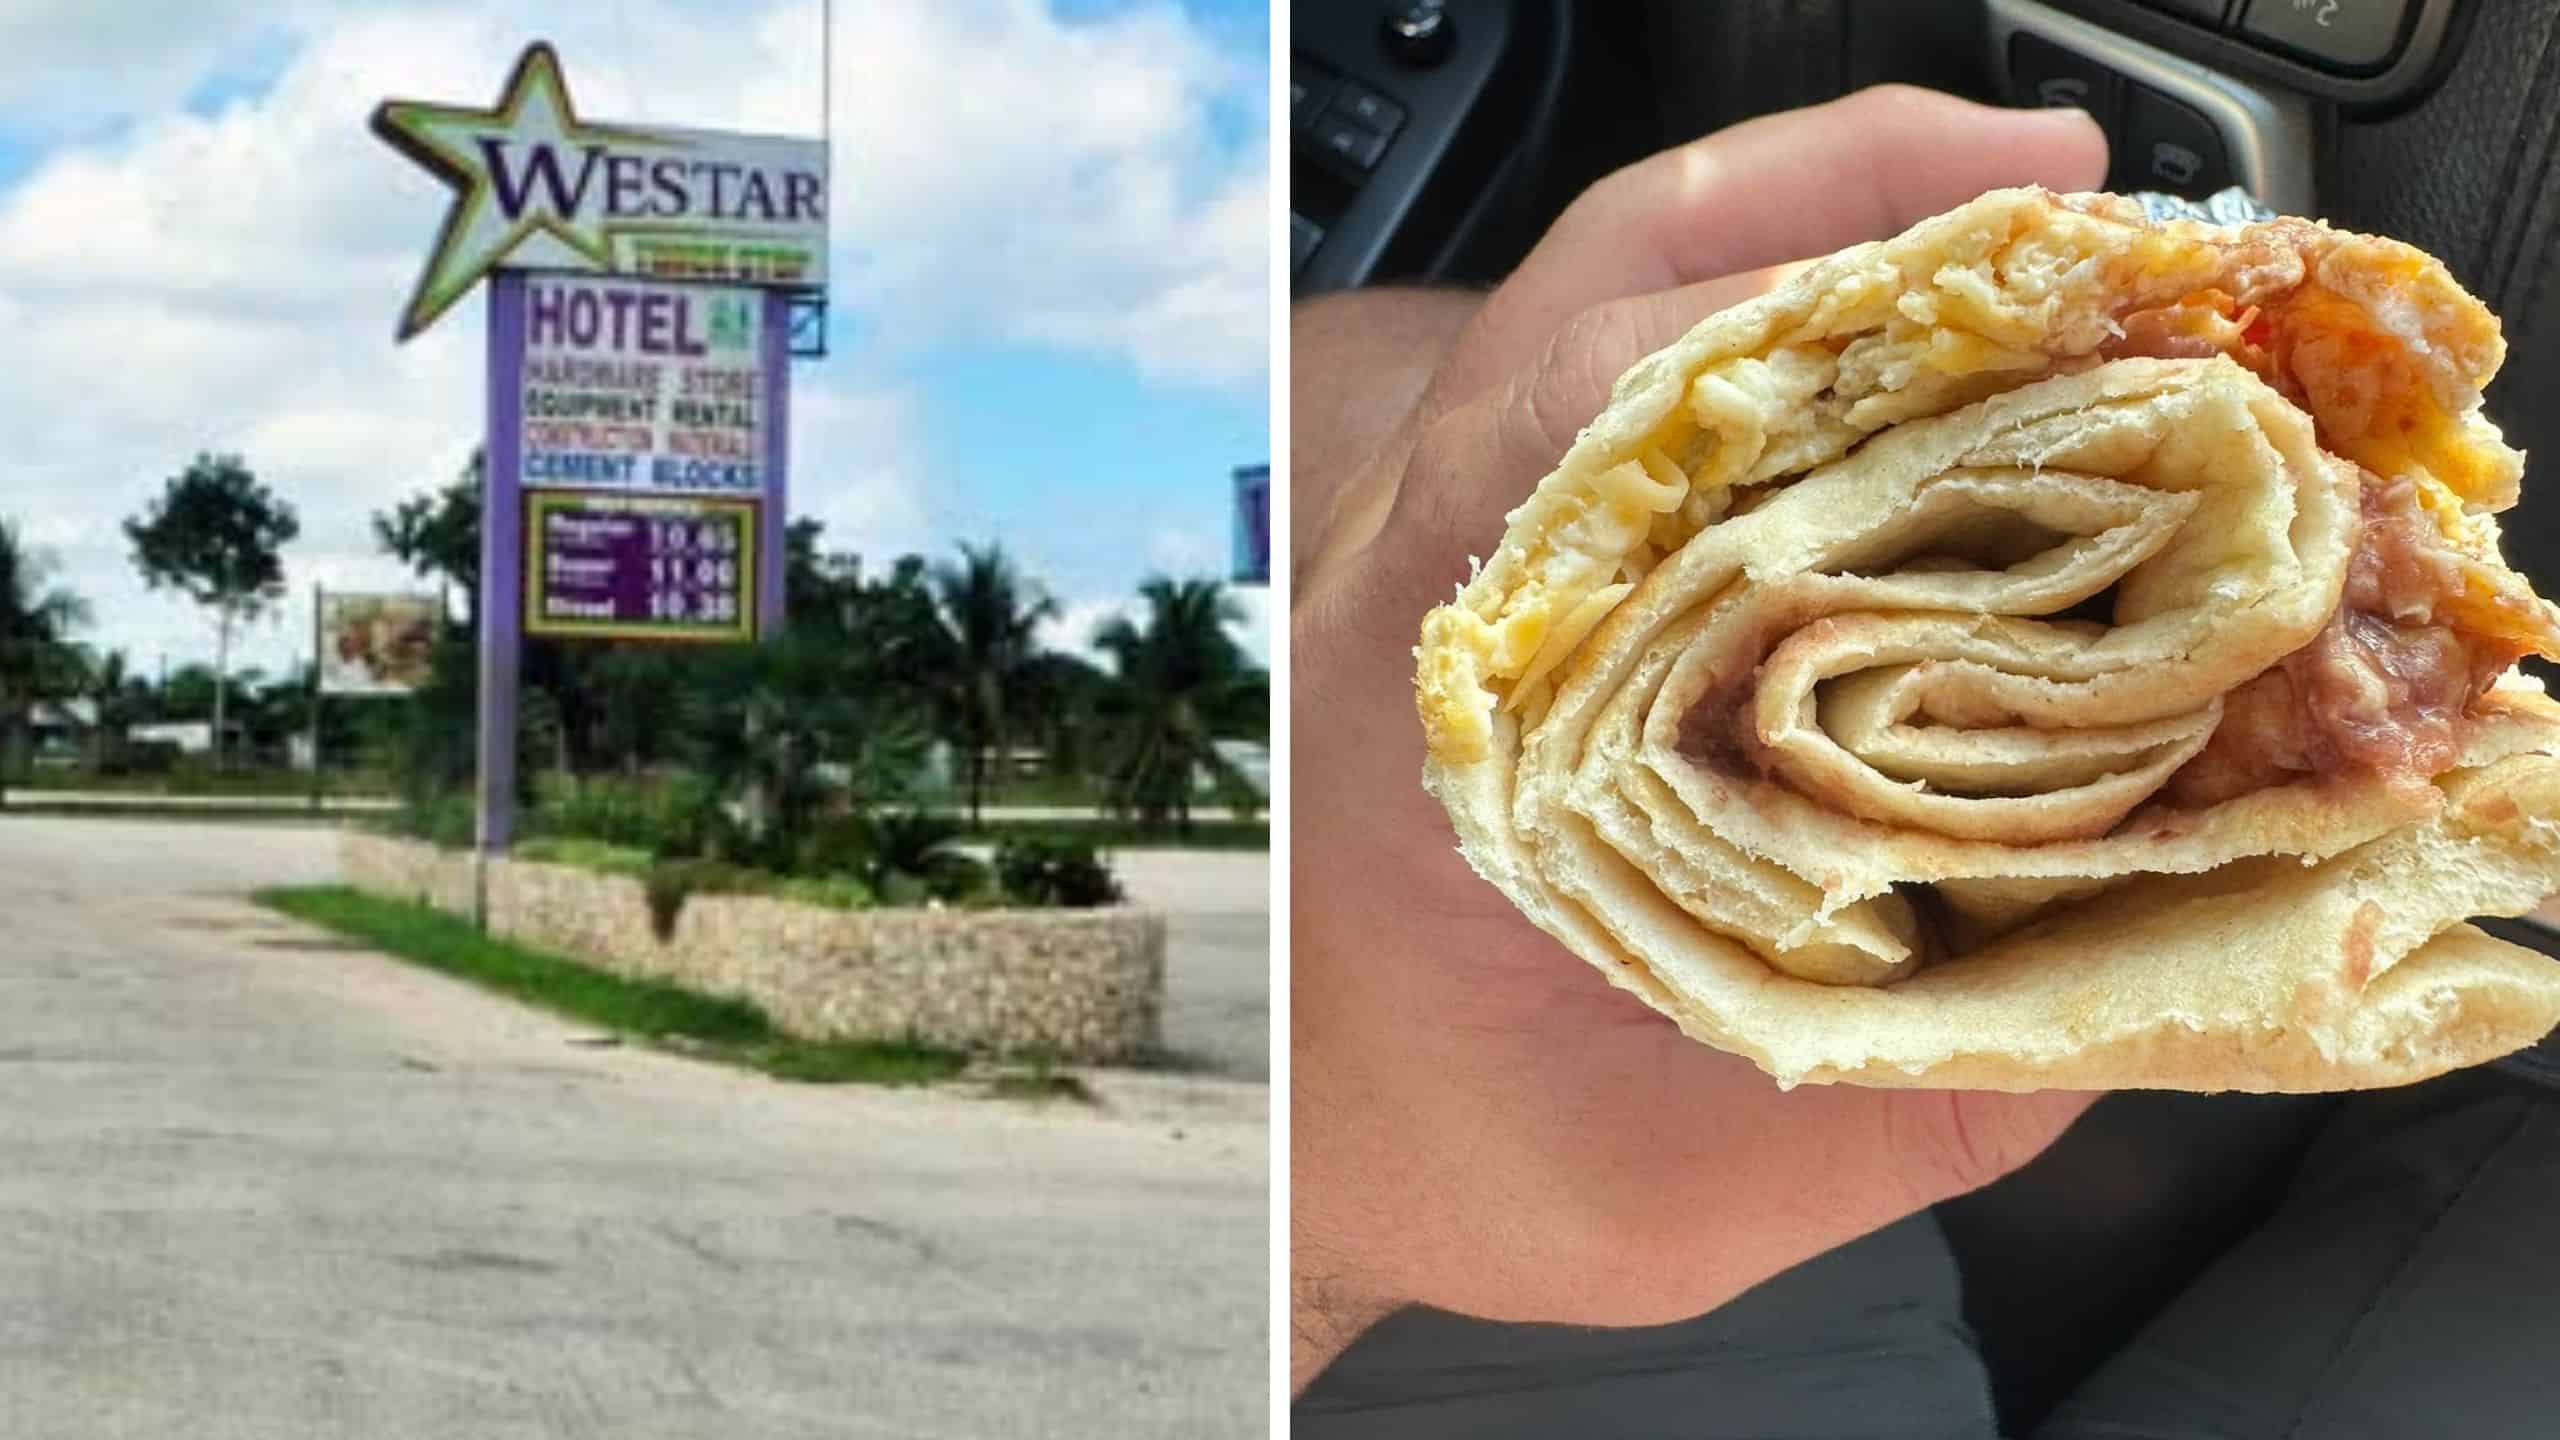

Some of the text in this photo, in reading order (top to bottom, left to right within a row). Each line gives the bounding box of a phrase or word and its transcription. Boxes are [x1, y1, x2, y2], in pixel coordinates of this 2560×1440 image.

[477, 136, 826, 222] WESTAR
[529, 287, 707, 355] HOTEL
[526, 355, 760, 400] HARDWARE STORE
[526, 387, 759, 429] EQUIPMENT RENTAL
[525, 449, 760, 489] CEMENT BLOCKS
